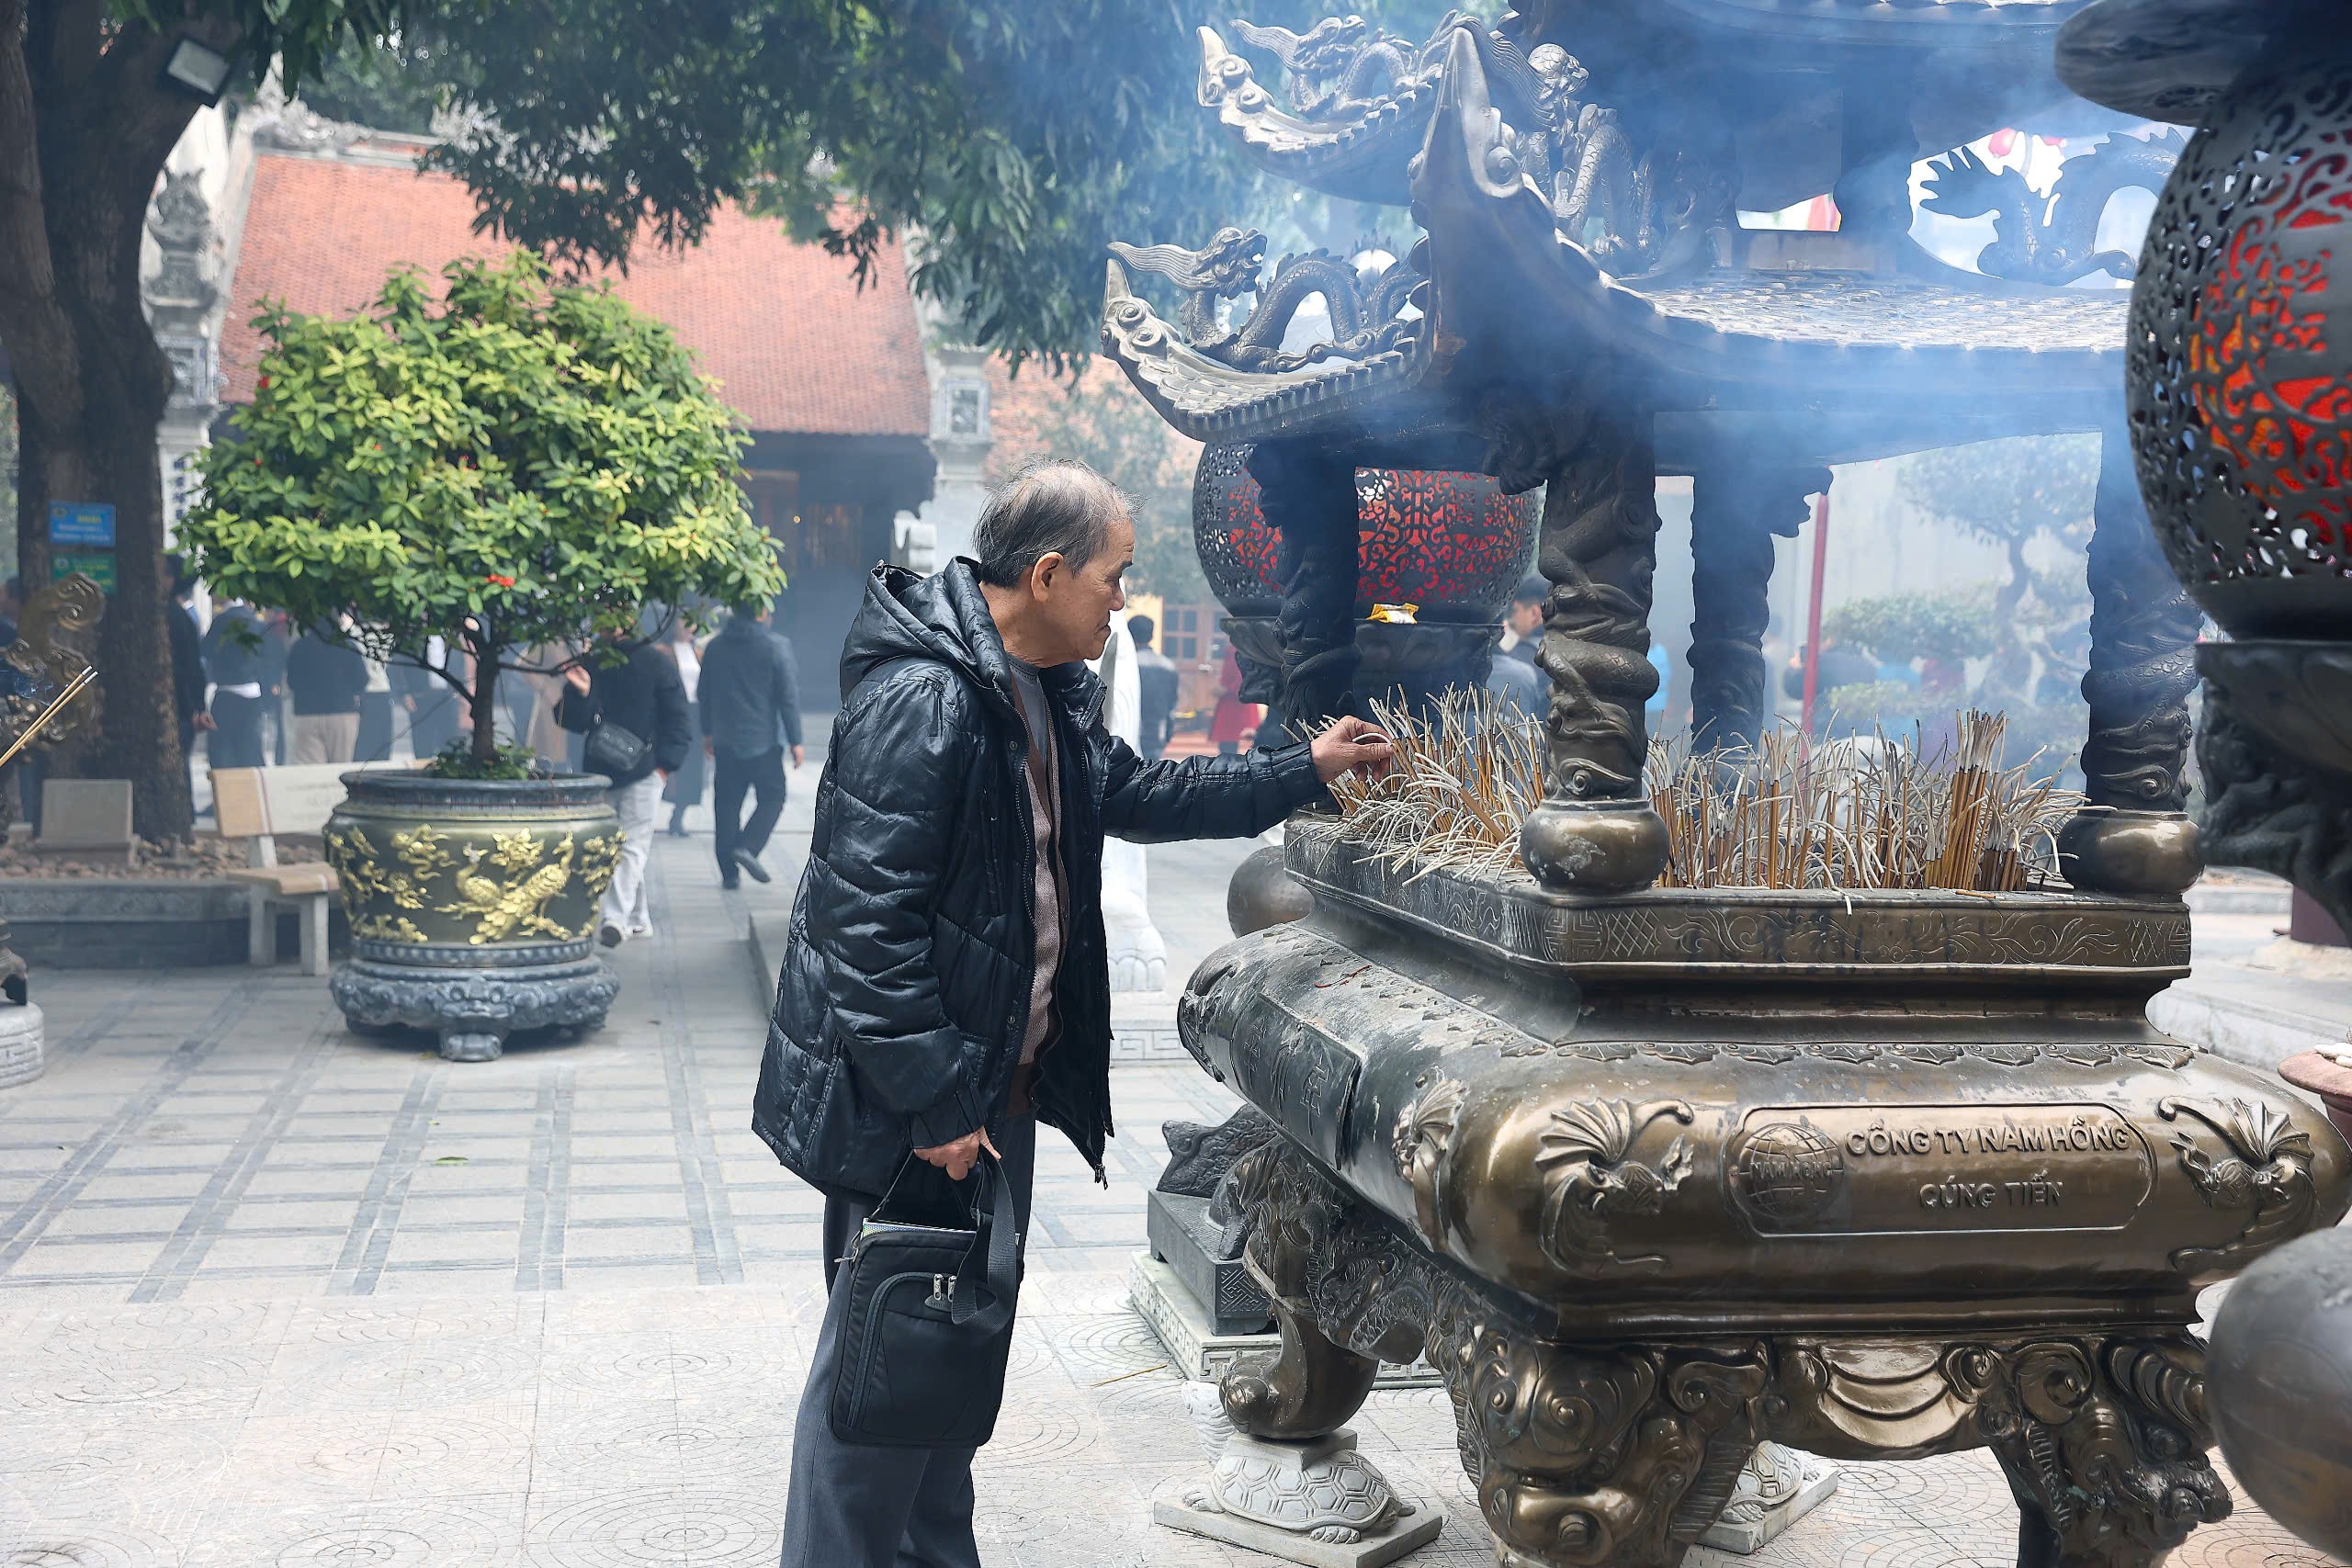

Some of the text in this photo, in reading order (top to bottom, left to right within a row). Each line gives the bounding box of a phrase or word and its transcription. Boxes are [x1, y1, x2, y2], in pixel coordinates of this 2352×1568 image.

[1846, 1119, 1931, 1155] CÔNG
[1934, 1126, 1972, 1154] TY
[1977, 1123, 2045, 1153] NAM
[1749, 1161, 1790, 1179] NAM
[1919, 1168, 2064, 1208] CÚNG TIẾN
